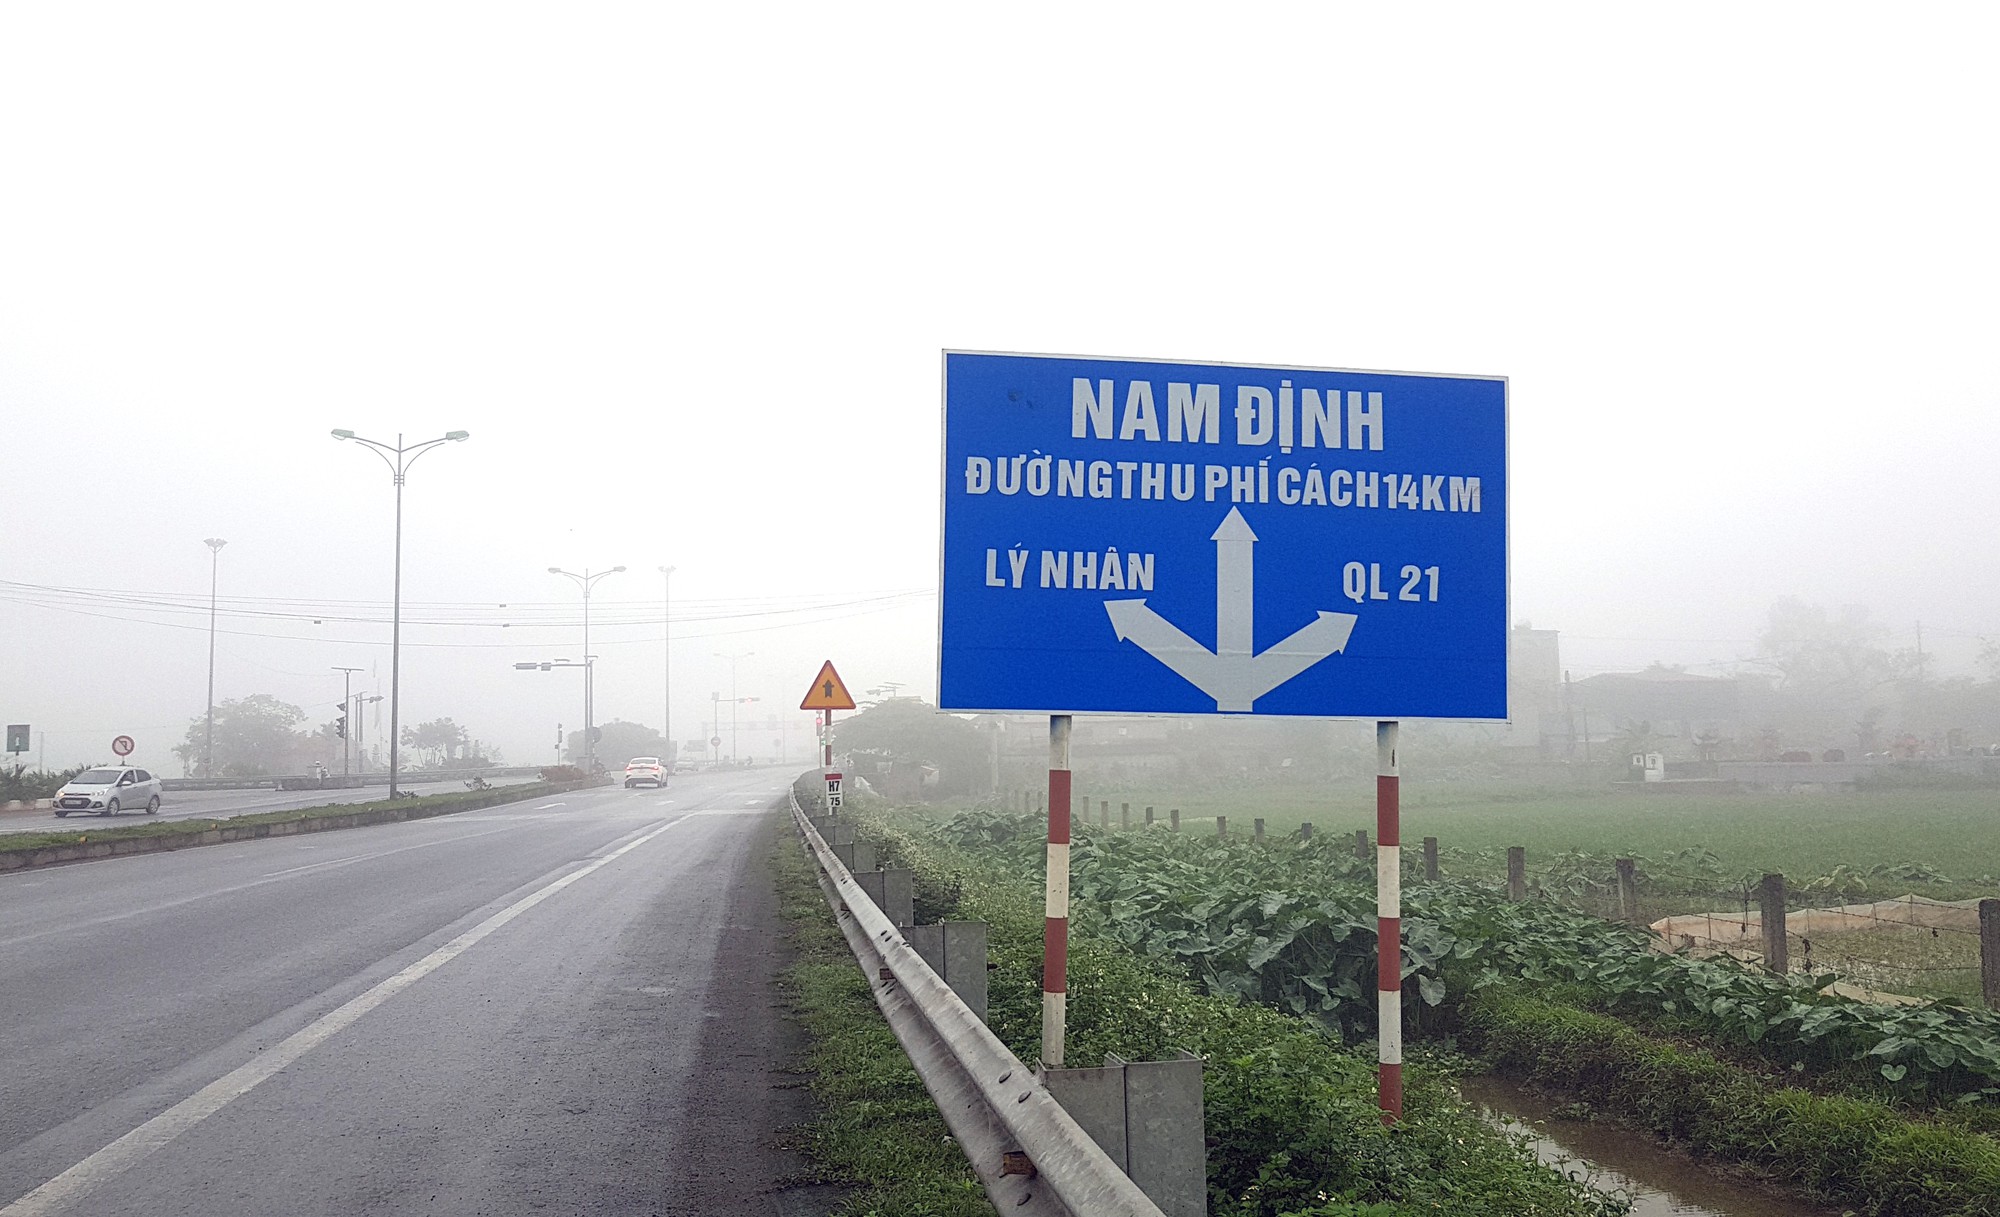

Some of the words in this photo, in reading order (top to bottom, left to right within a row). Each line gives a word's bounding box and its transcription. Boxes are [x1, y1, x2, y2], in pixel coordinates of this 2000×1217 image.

[1071, 377, 1220, 444] NAM
[1234, 379, 1384, 454] ĐỊNH
[1204, 455, 1272, 504] PHÍ
[985, 542, 1029, 589] LÝ
[1040, 546, 1155, 591] NHÂN
[1343, 561, 1389, 604] QL
[1398, 564, 1440, 602] 21
[828, 780, 840, 792] H7
[830, 797, 841, 806] 75
